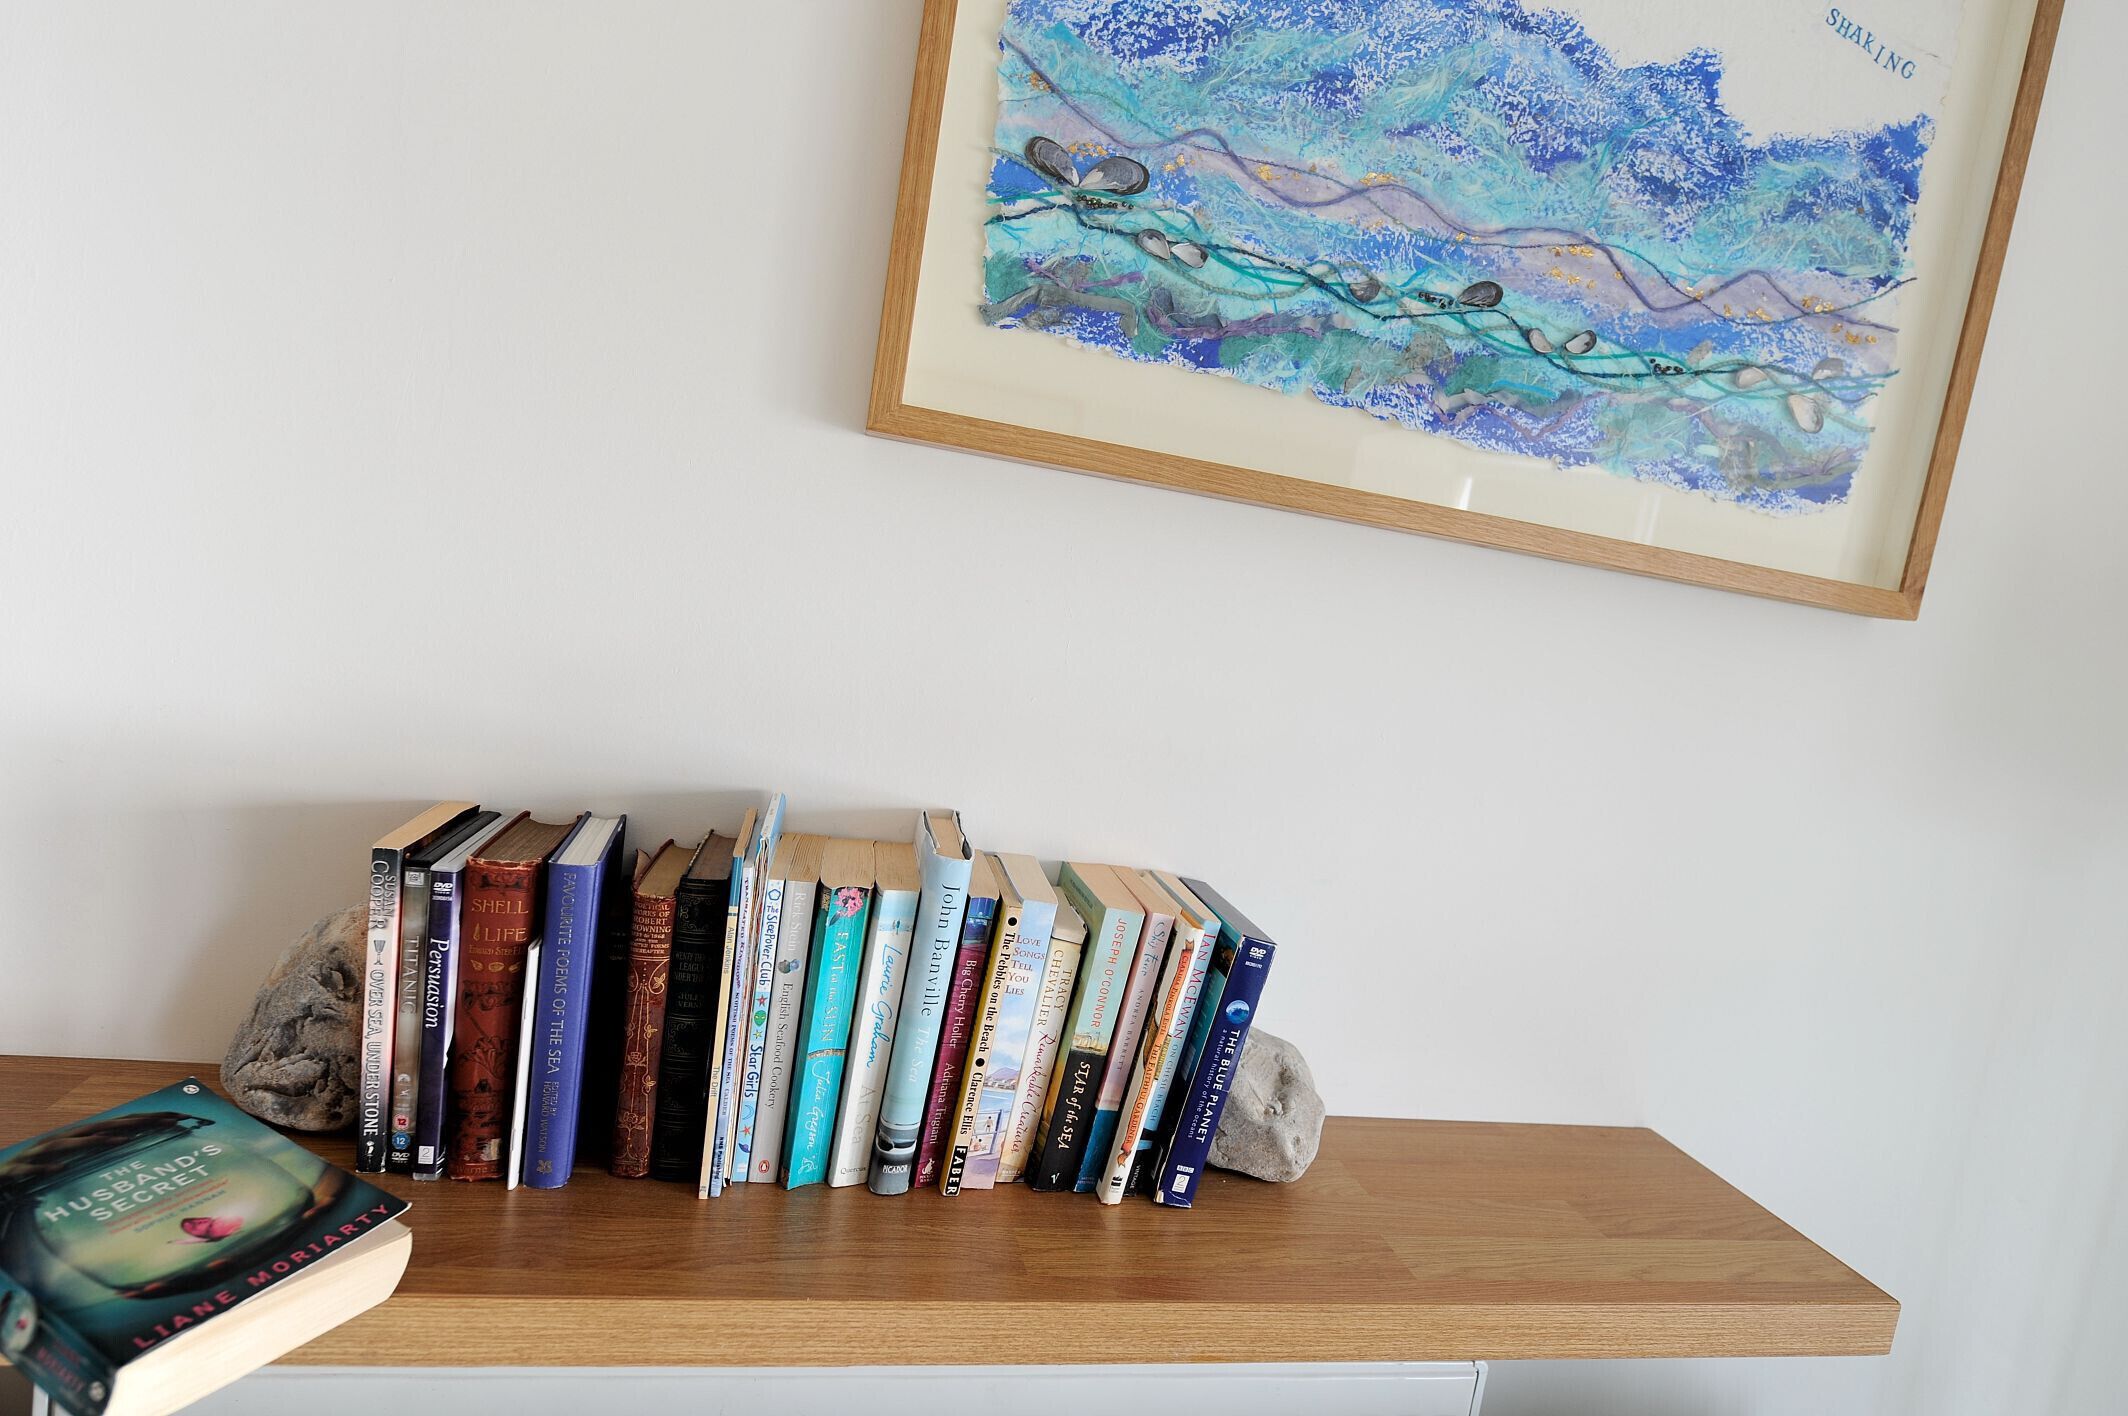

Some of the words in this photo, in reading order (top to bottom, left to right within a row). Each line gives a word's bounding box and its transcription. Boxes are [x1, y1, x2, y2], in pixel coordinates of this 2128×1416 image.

[1826, 8, 1916, 79] SHAKING
[369, 860, 390, 930] COOPER
[384, 876, 396, 917] SUSAN
[472, 899, 529, 914] SHELL
[558, 872, 577, 945] FAVOURITE
[766, 905, 779, 914] The
[794, 892, 806, 918] Rick
[938, 883, 961, 929] John
[485, 928, 528, 942] LIFE
[726, 927, 735, 944] Alan
[788, 921, 803, 952] Stein
[1001, 932, 1016, 950] The
[1016, 934, 1041, 947] LOVE
[1107, 918, 1127, 965] JOSEPH
[1147, 921, 1165, 949] Ship
[1196, 933, 1216, 961] IAN
[723, 945, 733, 974] Jenkins
[832, 932, 849, 972] EAST
[1012, 948, 1046, 960] SONGS
[1140, 952, 1159, 977] Fever
[1250, 946, 1267, 955] DVD
[400, 936, 420, 1015] TITANIC
[554, 950, 571, 994] POEMS
[759, 962, 772, 986] Club
[879, 944, 902, 996] Laurie
[921, 938, 950, 1017] Banville
[962, 960, 977, 976] Big
[993, 953, 1011, 990] Pebbles
[1007, 972, 1029, 984] YOU
[1010, 960, 1033, 972] TELL
[369, 971, 385, 1007] OVER
[425, 938, 449, 1028] Persuasion
[955, 979, 974, 1016] Cherry
[1004, 984, 1025, 996] LIES
[1037, 950, 1063, 1026] CHEVALIER
[1054, 970, 1072, 1012] TRACY
[552, 1002, 566, 1017] OF
[778, 983, 793, 1020] English
[990, 992, 999, 1004] on
[1091, 969, 1114, 1028] O'CONNOR
[1128, 989, 1145, 1025] ANDREA
[821, 1004, 839, 1042] SUN
[986, 1004, 999, 1022] the
[549, 1020, 564, 1045] THE
[773, 1024, 788, 1064] Seafood
[866, 1000, 893, 1072] Graham
[915, 1026, 931, 1055] The
[950, 1017, 965, 1049] Holler
[979, 1024, 995, 1052] Beach
[1225, 1029, 1241, 1055] THE
[547, 1049, 562, 1074] SEA
[750, 1044, 763, 1066] Star
[1118, 1030, 1133, 1071] BARRETT
[1151, 1043, 1161, 1061] THE
[1170, 1044, 1179, 1058] ON
[1215, 1035, 1225, 1060] natural
[364, 1042, 382, 1090] UNDER
[712, 1066, 721, 1080] The
[910, 1060, 923, 1083] Sea
[1026, 1029, 1057, 1100] Remarkable
[1073, 1061, 1091, 1094] STAR
[1159, 1061, 1173, 1089] CHESIL
[1204, 1060, 1217, 1089] history
[1213, 1058, 1231, 1091] BLUE
[709, 1080, 719, 1097] Drift
[744, 1071, 760, 1098] Girls
[765, 1066, 783, 1109] Cookery
[858, 1085, 876, 1106] At
[938, 1062, 954, 1104] Adriana
[964, 1072, 983, 1113] Clarence
[1141, 1061, 1155, 1101] FAITHFUL
[1202, 1091, 1209, 1100] of
[542, 1081, 552, 1117] HOWARD
[1065, 1096, 1082, 1110] of
[1150, 1094, 1164, 1122] BEACH
[1196, 1099, 1205, 1113] the
[363, 1092, 380, 1136] STONE
[852, 1113, 871, 1144] Sea
[929, 1104, 947, 1145] Trigiani
[960, 1114, 974, 1135] Ellis
[1012, 1101, 1038, 1153] Creatures
[1065, 1110, 1079, 1125] the
[1125, 1102, 1144, 1144] GARDENER
[1188, 1114, 1200, 1138] oceans
[1195, 1094, 1219, 1144] PLANET
[396, 1137, 406, 1145] 12
[537, 1119, 549, 1153] WATSON
[1057, 1125, 1075, 1150] SEA
[44, 1144, 222, 1222] HUSBAND'S
[99, 1160, 147, 1181] THE
[882, 1164, 909, 1174] PICADOR
[947, 1147, 966, 1194] FABER
[1130, 1164, 1141, 1190] VINTAGE
[90, 1165, 208, 1221] SECRET
[133, 1289, 238, 1350] LIANE
[247, 1204, 391, 1288] MORIARTY
